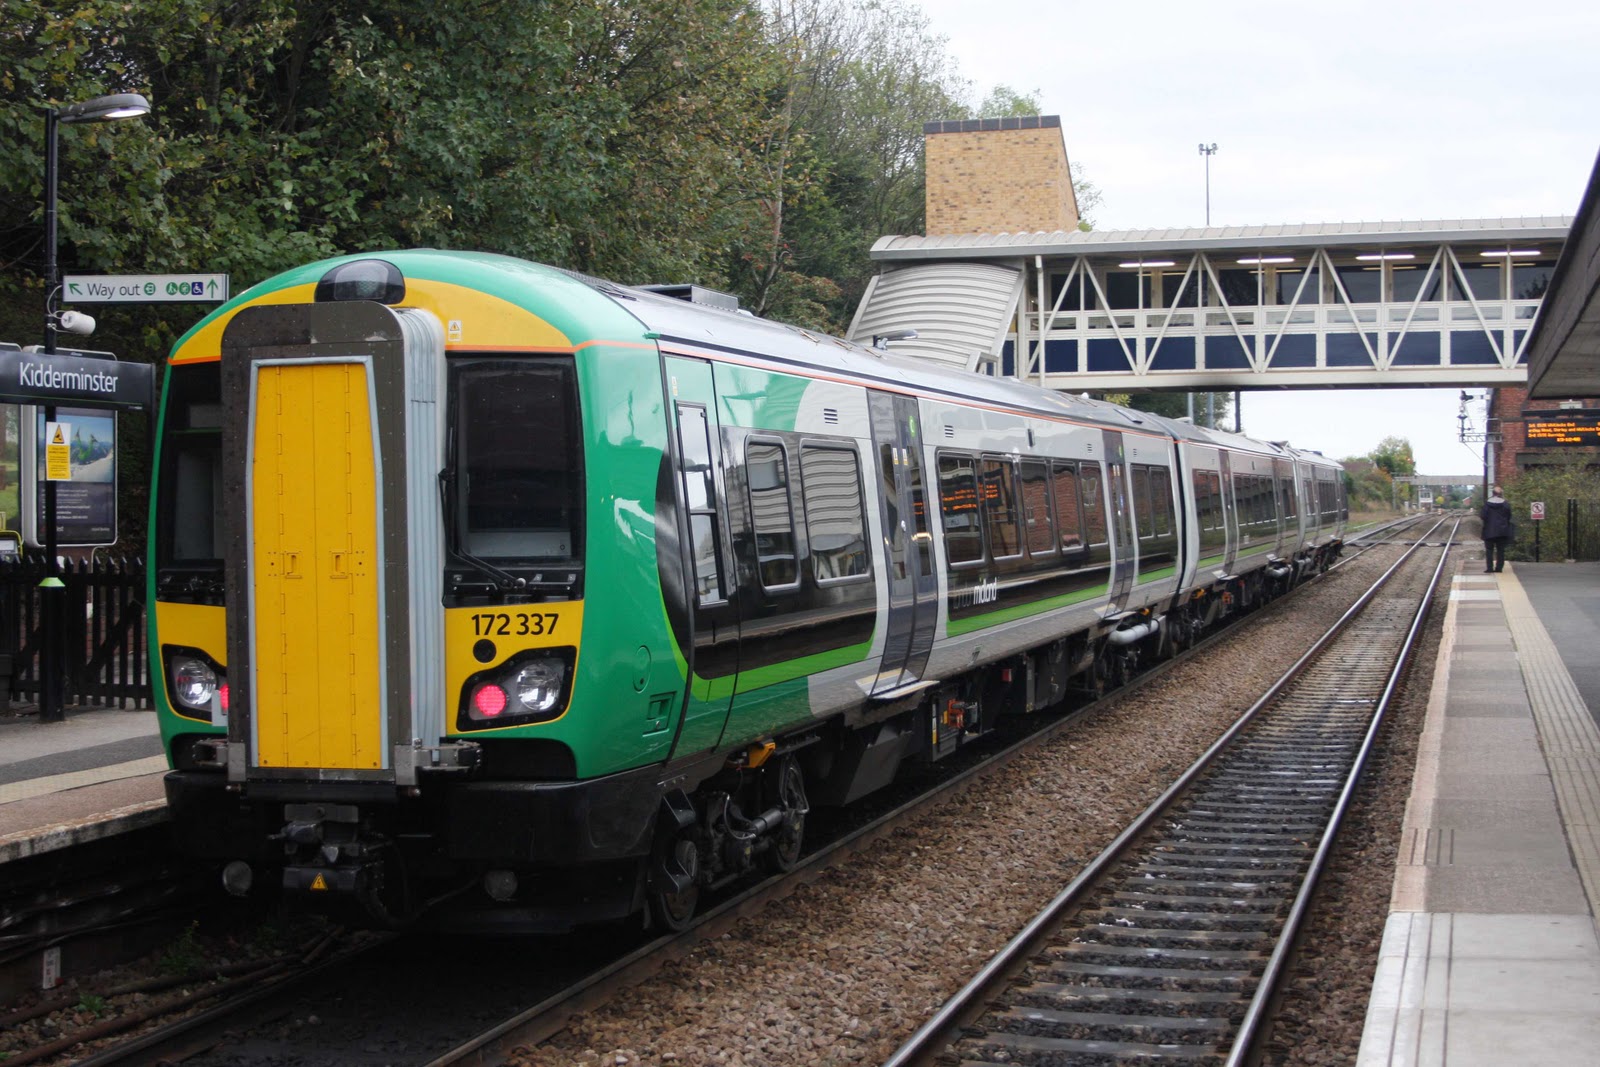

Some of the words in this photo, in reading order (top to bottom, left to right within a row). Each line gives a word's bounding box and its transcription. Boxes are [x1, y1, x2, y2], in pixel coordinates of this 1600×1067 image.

[87, 283, 115, 299] Way
[119, 284, 141, 296] out
[19, 362, 119, 393] Kidderminster
[471, 613, 511, 636] 172
[516, 613, 560, 636] 337
